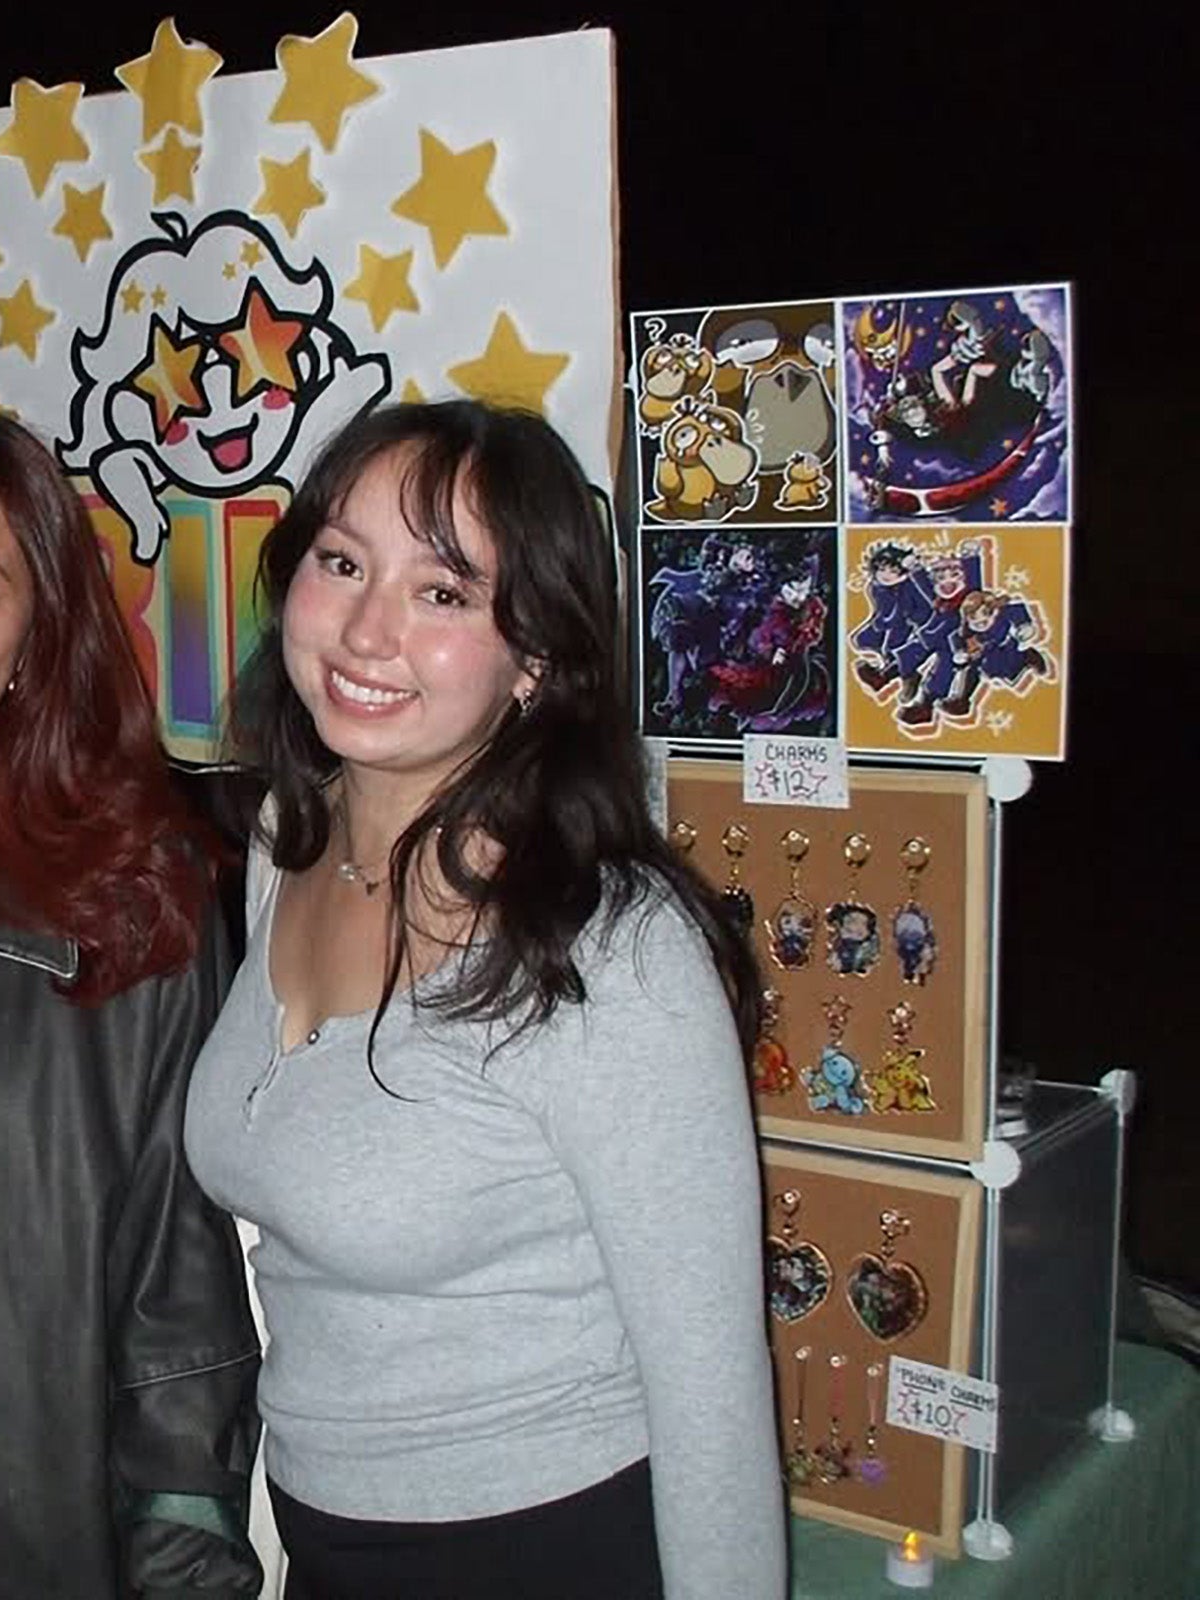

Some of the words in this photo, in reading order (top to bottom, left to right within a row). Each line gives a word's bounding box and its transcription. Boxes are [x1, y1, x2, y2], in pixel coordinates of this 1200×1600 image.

[765, 742, 829, 763] CHARMS
[767, 768, 810, 796] $12
[910, 1400, 952, 1427] $10
